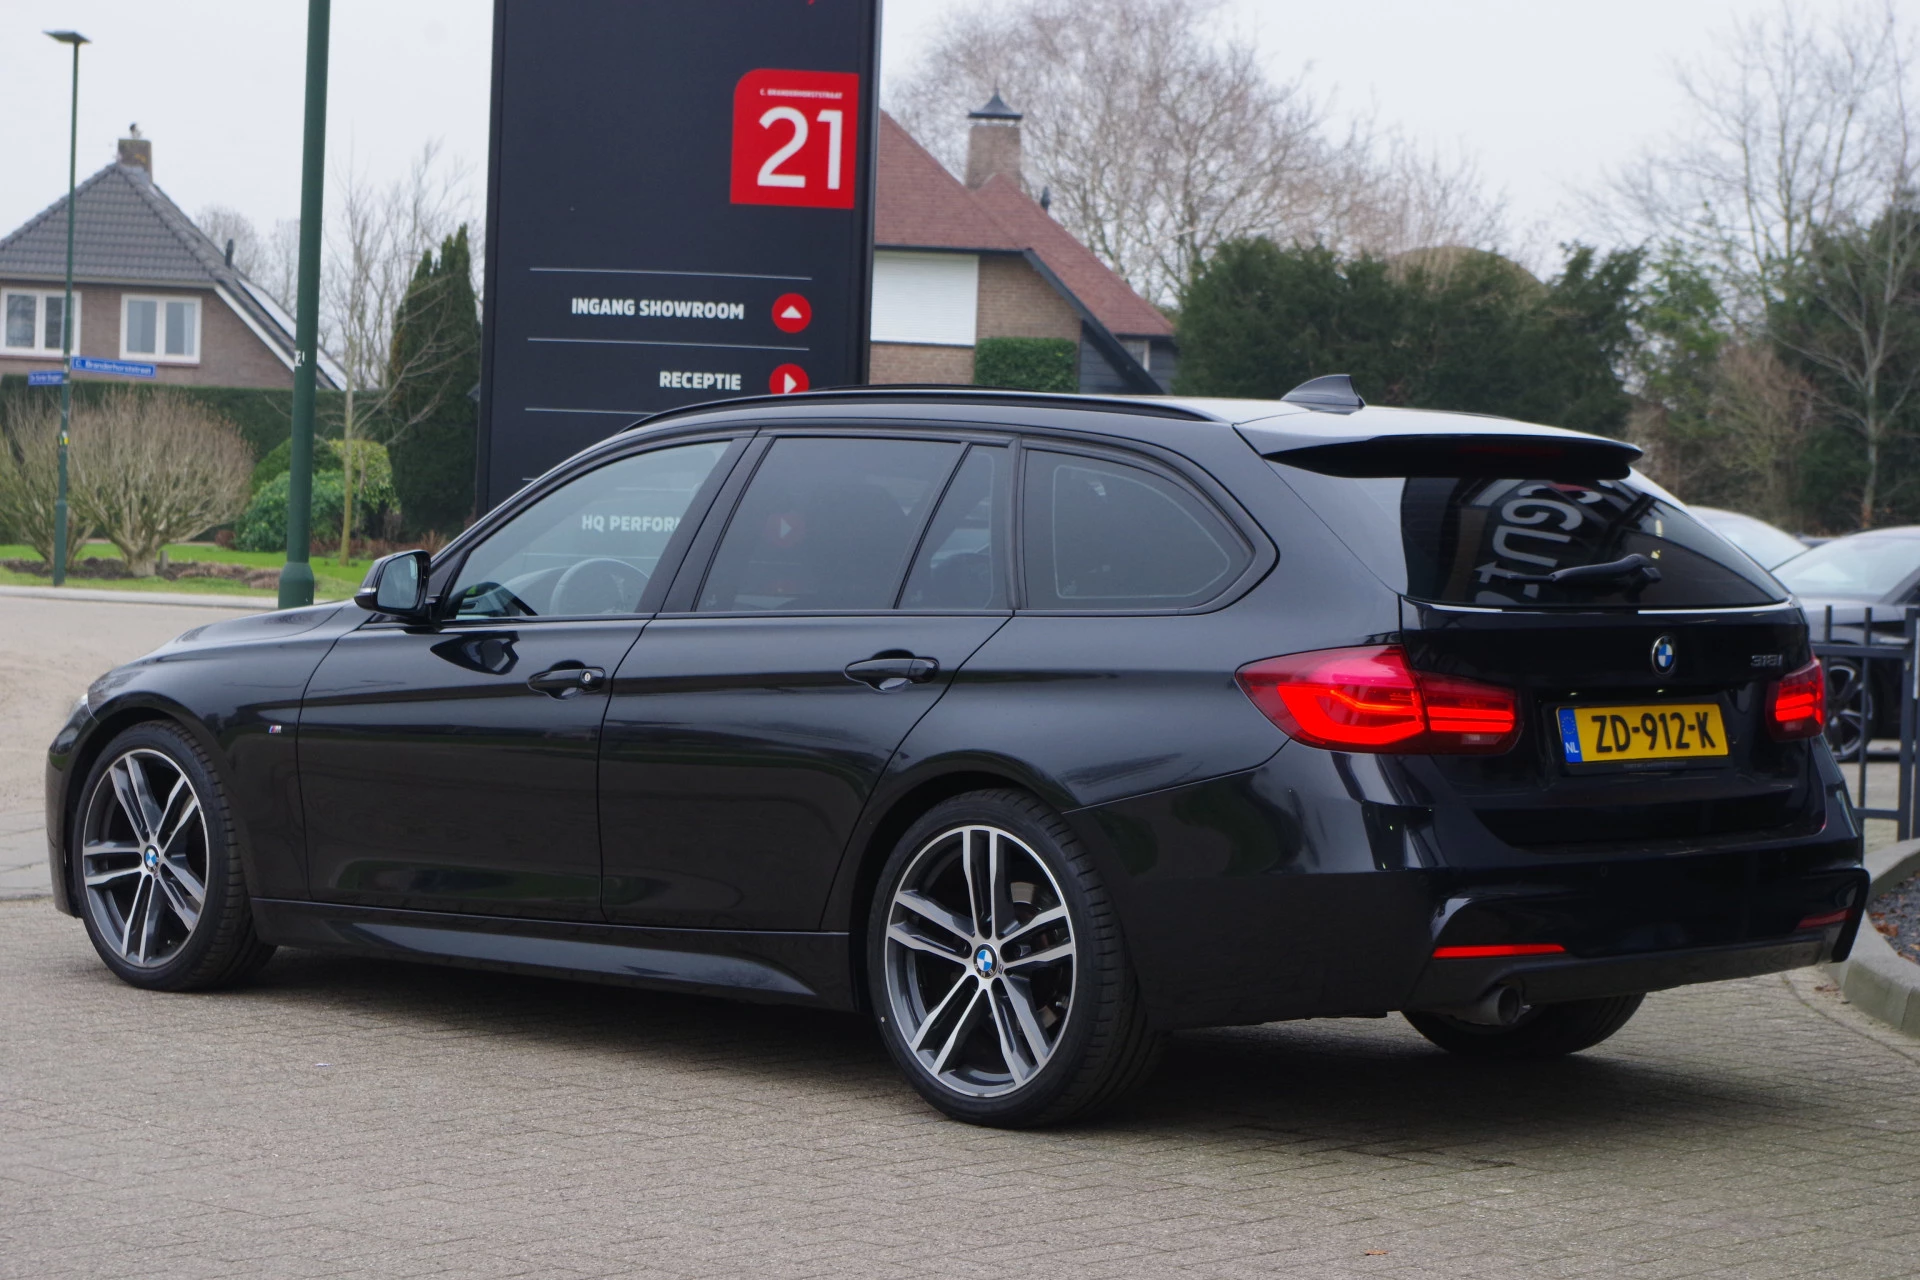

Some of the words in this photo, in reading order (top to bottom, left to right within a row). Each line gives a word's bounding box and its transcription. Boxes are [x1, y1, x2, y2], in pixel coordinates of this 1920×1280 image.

[757, 106, 843, 190] 21
[571, 297, 635, 316] INGANG
[639, 299, 745, 320] SHOWROOM
[659, 371, 741, 391] RECEPTIE
[581, 514, 605, 533] HQ
[1591, 711, 1717, 754] ZD-912-K
[1565, 742, 1579, 754] NL
